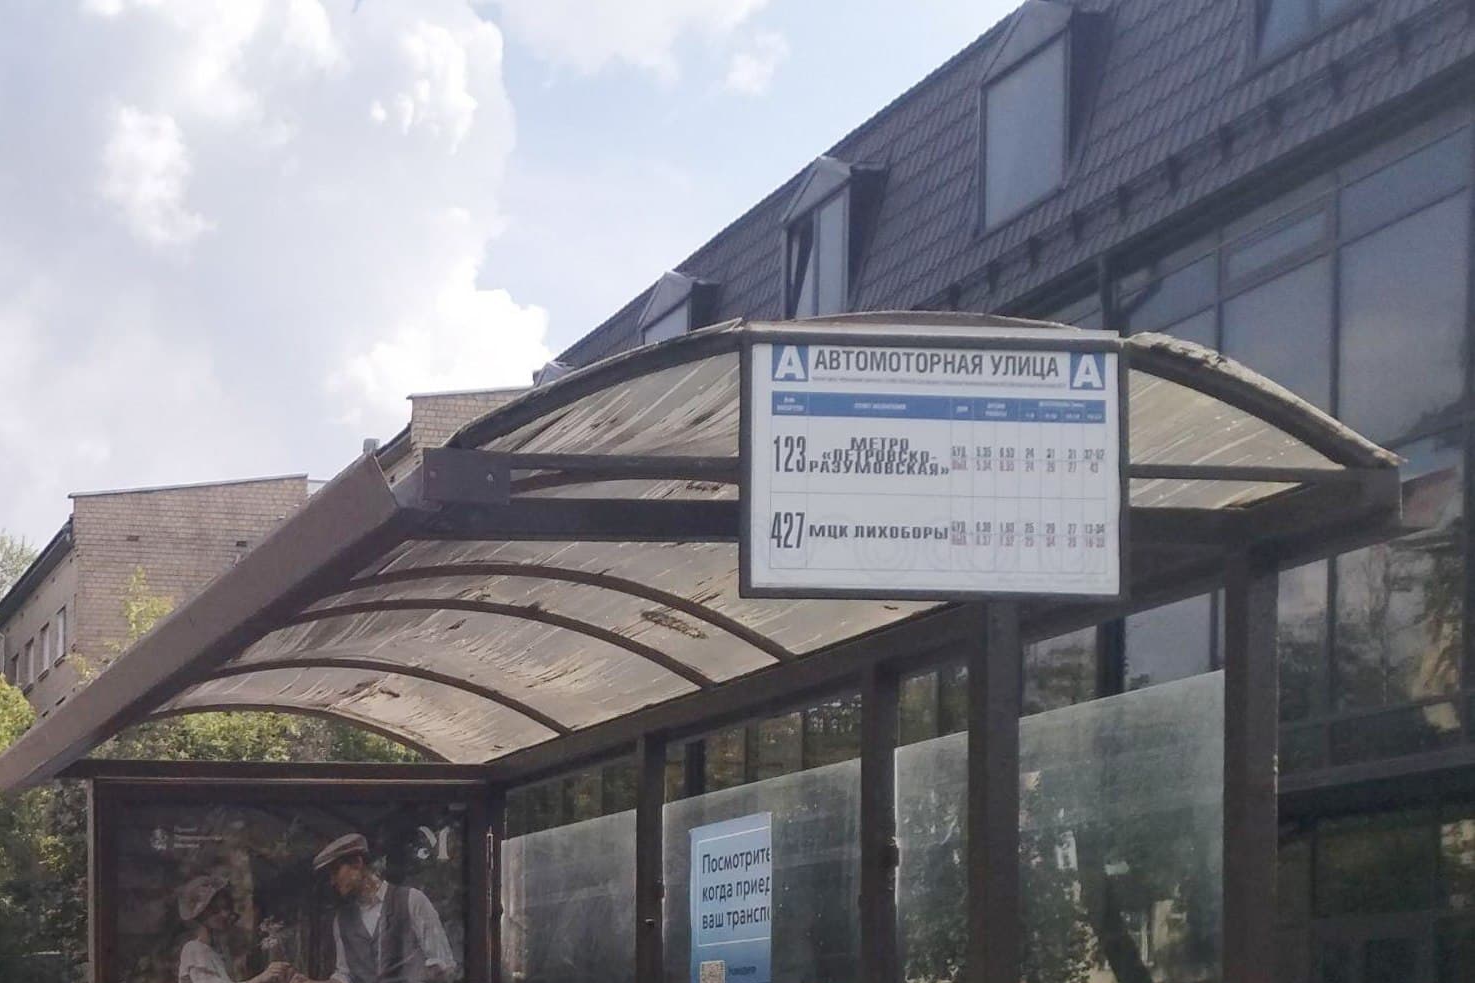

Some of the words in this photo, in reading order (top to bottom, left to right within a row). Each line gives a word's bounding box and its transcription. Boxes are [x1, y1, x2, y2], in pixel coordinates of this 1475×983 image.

[814, 349, 983, 375] АВТОМОТОРНАЯ
[990, 354, 1059, 380] УЛИЦА
[773, 435, 806, 473] 123
[850, 437, 909, 450] МЕТРО
[809, 460, 950, 476] РАЗУМОВСКАЯ»
[770, 511, 806, 548] 427
[809, 524, 849, 539] МЦК
[854, 525, 949, 540] ЛИХОБОРЫ
[702, 883, 733, 902] когда
[702, 912, 724, 930] ваш
[726, 906, 770, 931] трансп
